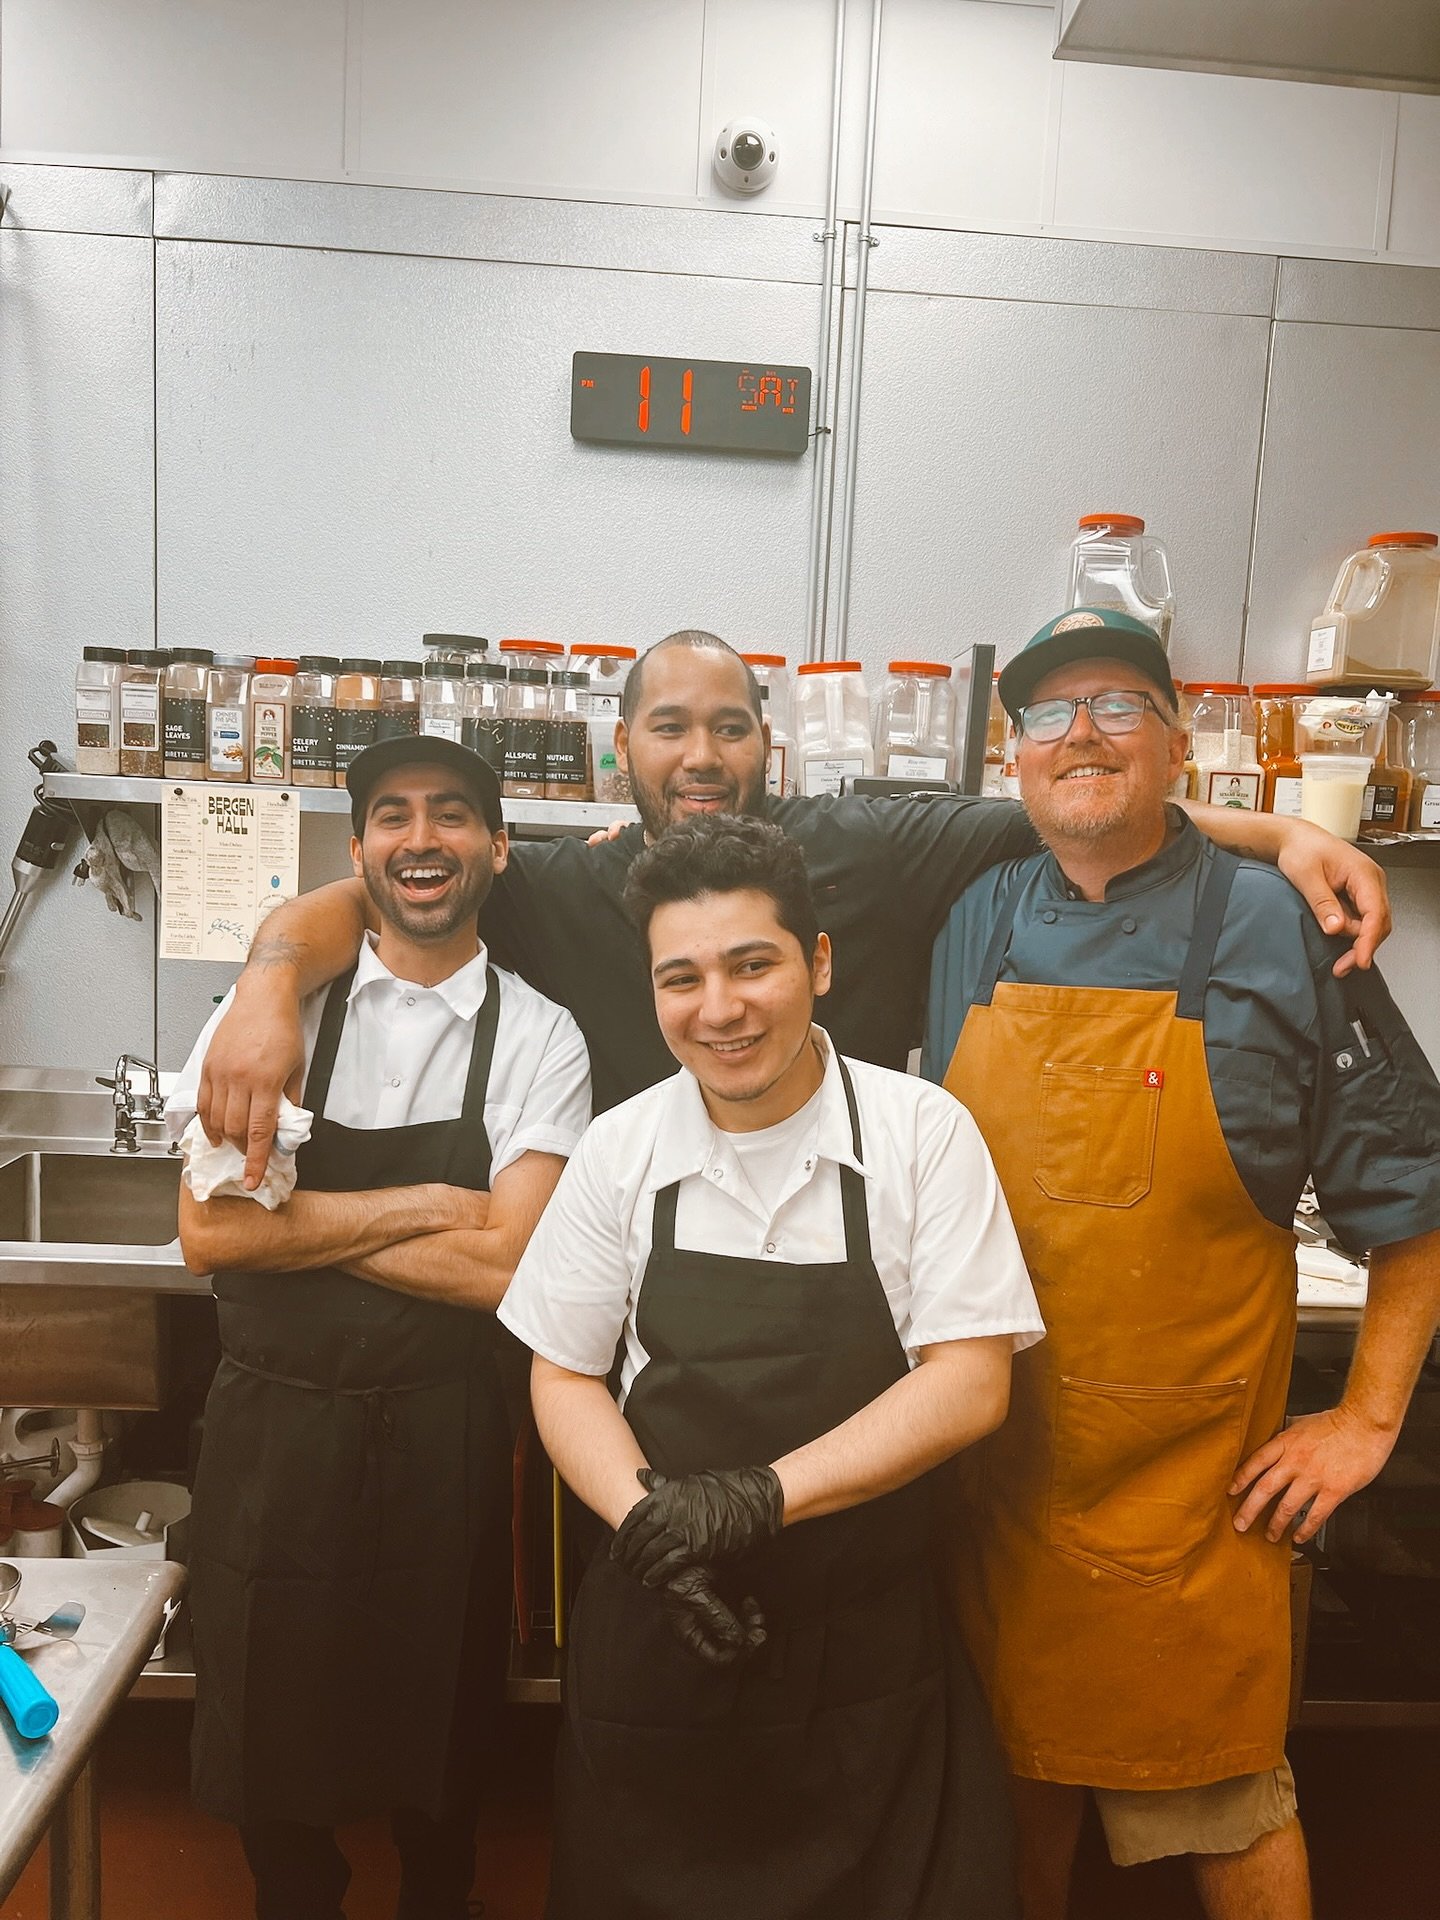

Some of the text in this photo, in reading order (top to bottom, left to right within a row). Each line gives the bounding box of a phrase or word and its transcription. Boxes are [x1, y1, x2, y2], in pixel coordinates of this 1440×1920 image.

[581, 379, 594, 388] PM
[165, 724, 183, 732] SAGE
[165, 732, 191, 740] LEAVES
[293, 738, 319, 746] CELERY
[504, 751, 537, 760] ALLSPICE
[504, 770, 528, 778] DIRETTA
[546, 772, 569, 780] DIRETTA
[208, 796, 254, 816] BERGEN
[216, 815, 248, 835] HALL
[1148, 1071, 1159, 1085] &
